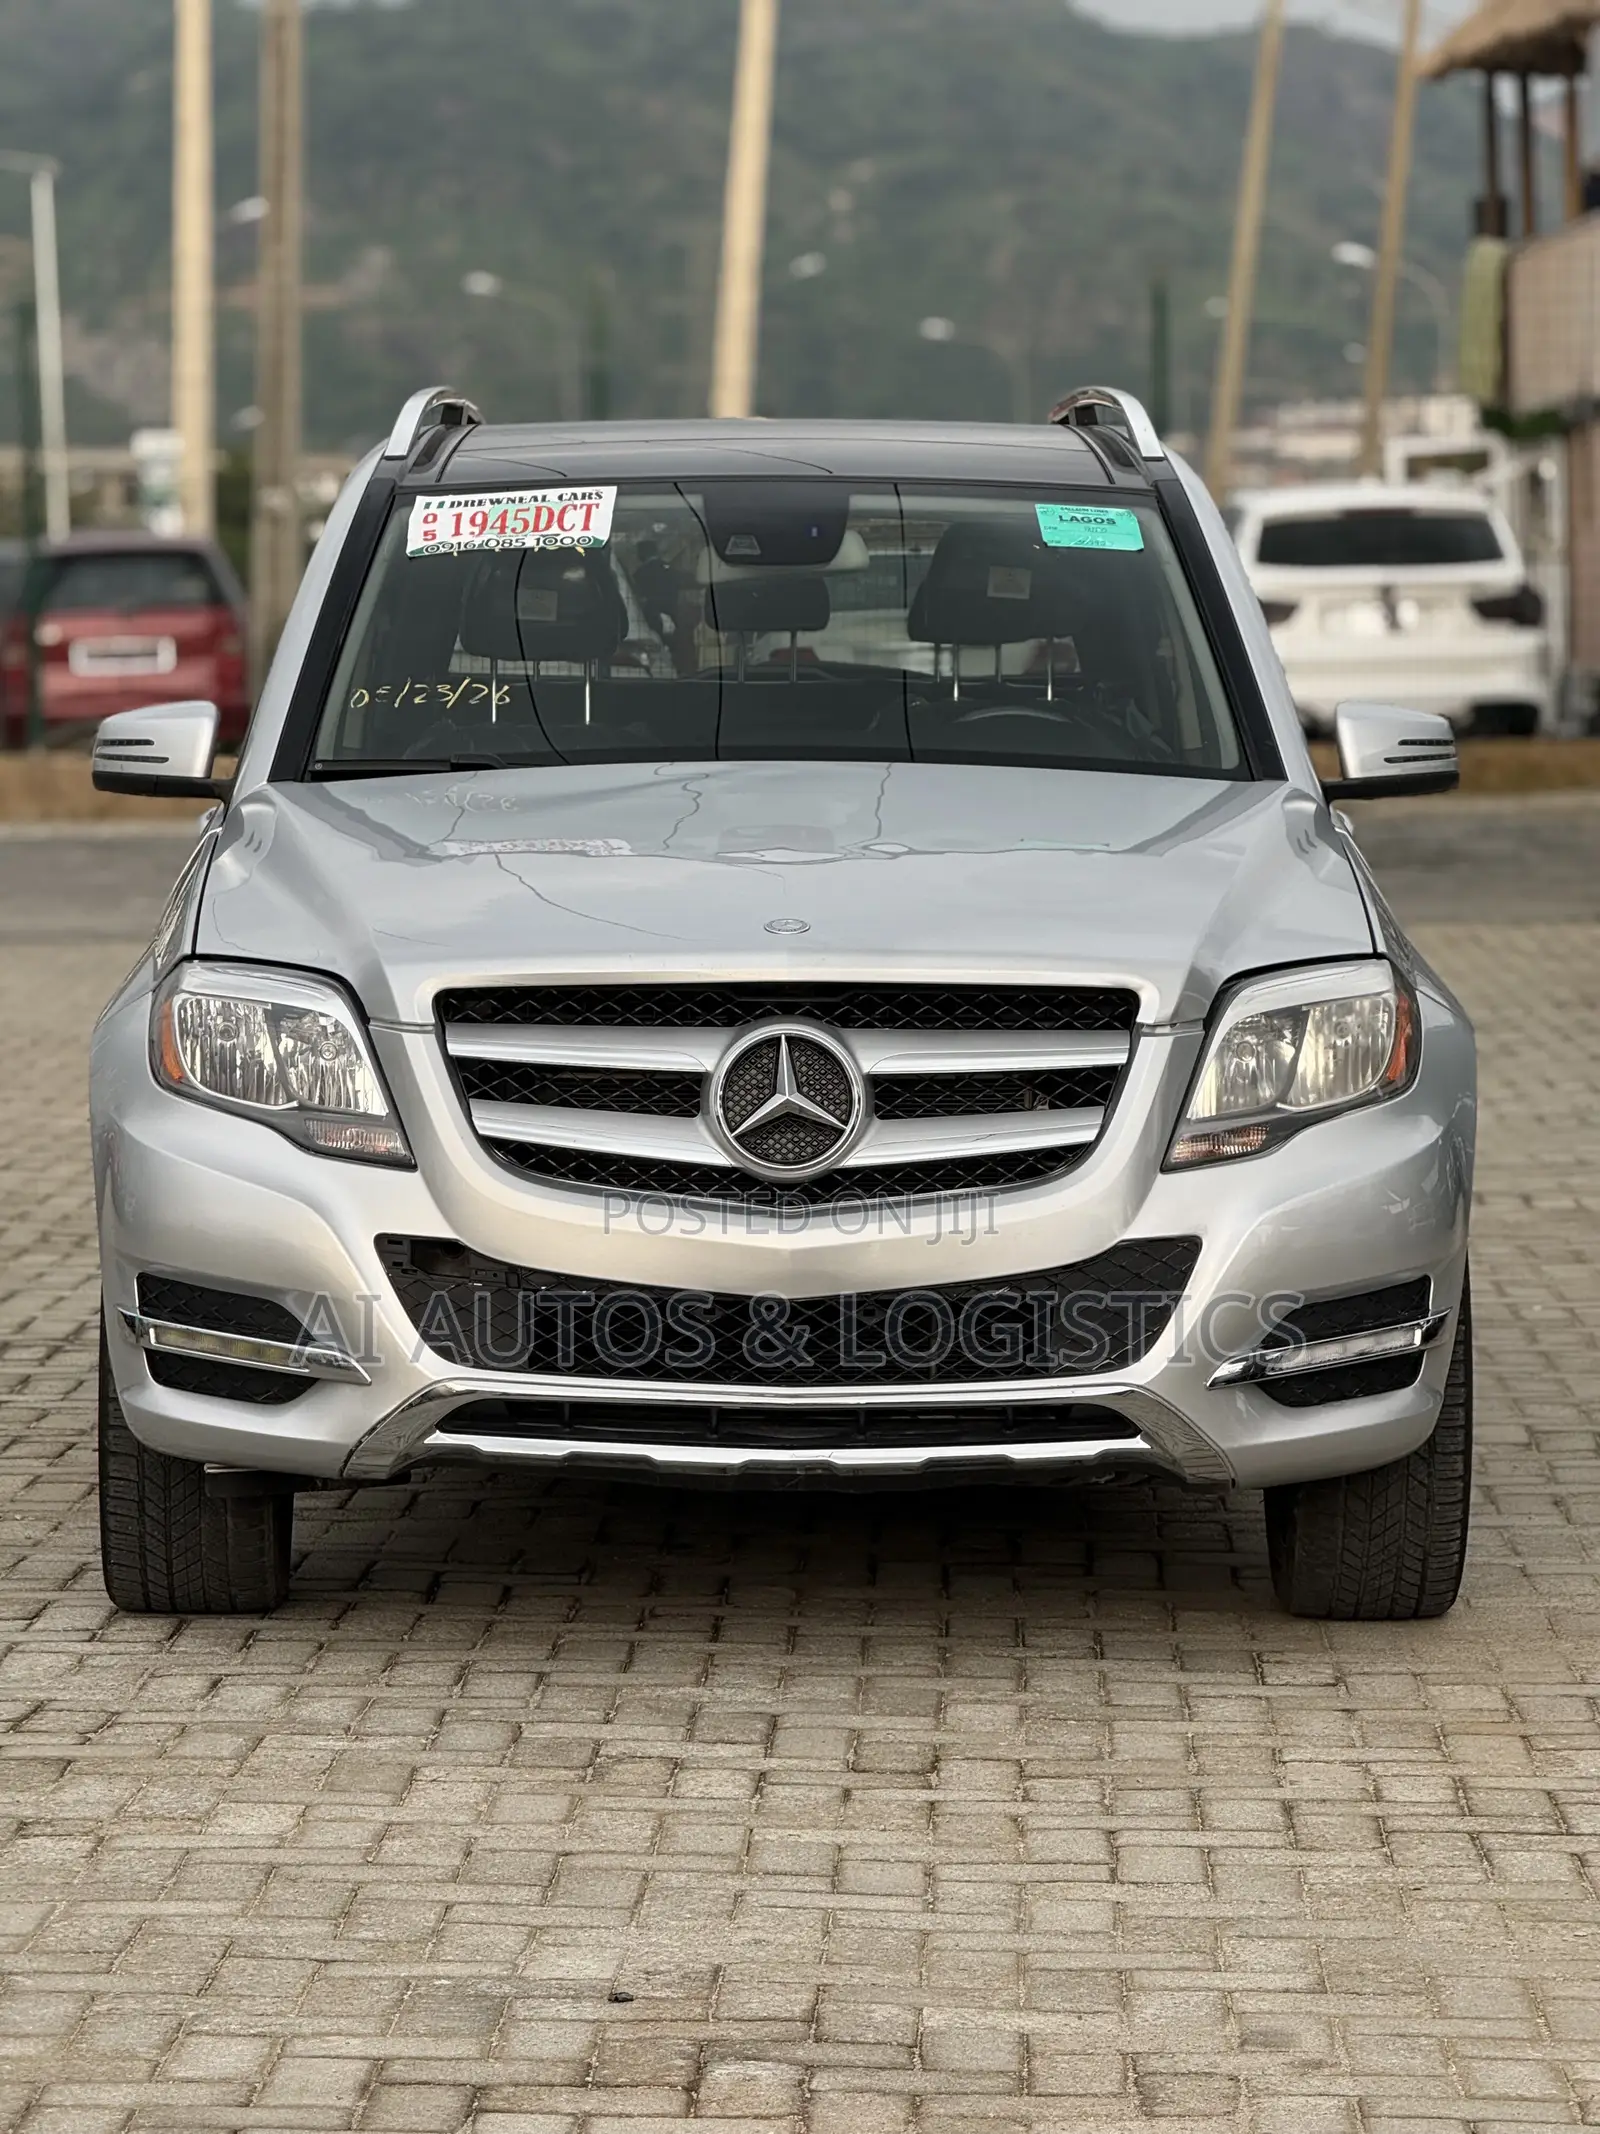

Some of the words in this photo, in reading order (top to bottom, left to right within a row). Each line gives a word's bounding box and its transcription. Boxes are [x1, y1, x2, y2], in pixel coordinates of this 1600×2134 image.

[447, 494, 550, 509] DREWNEAL
[557, 491, 604, 502] CARS
[451, 502, 600, 538] 1945DCT
[1058, 515, 1117, 525] LAGOS
[483, 536, 526, 549] 085
[534, 535, 593, 547] 1000
